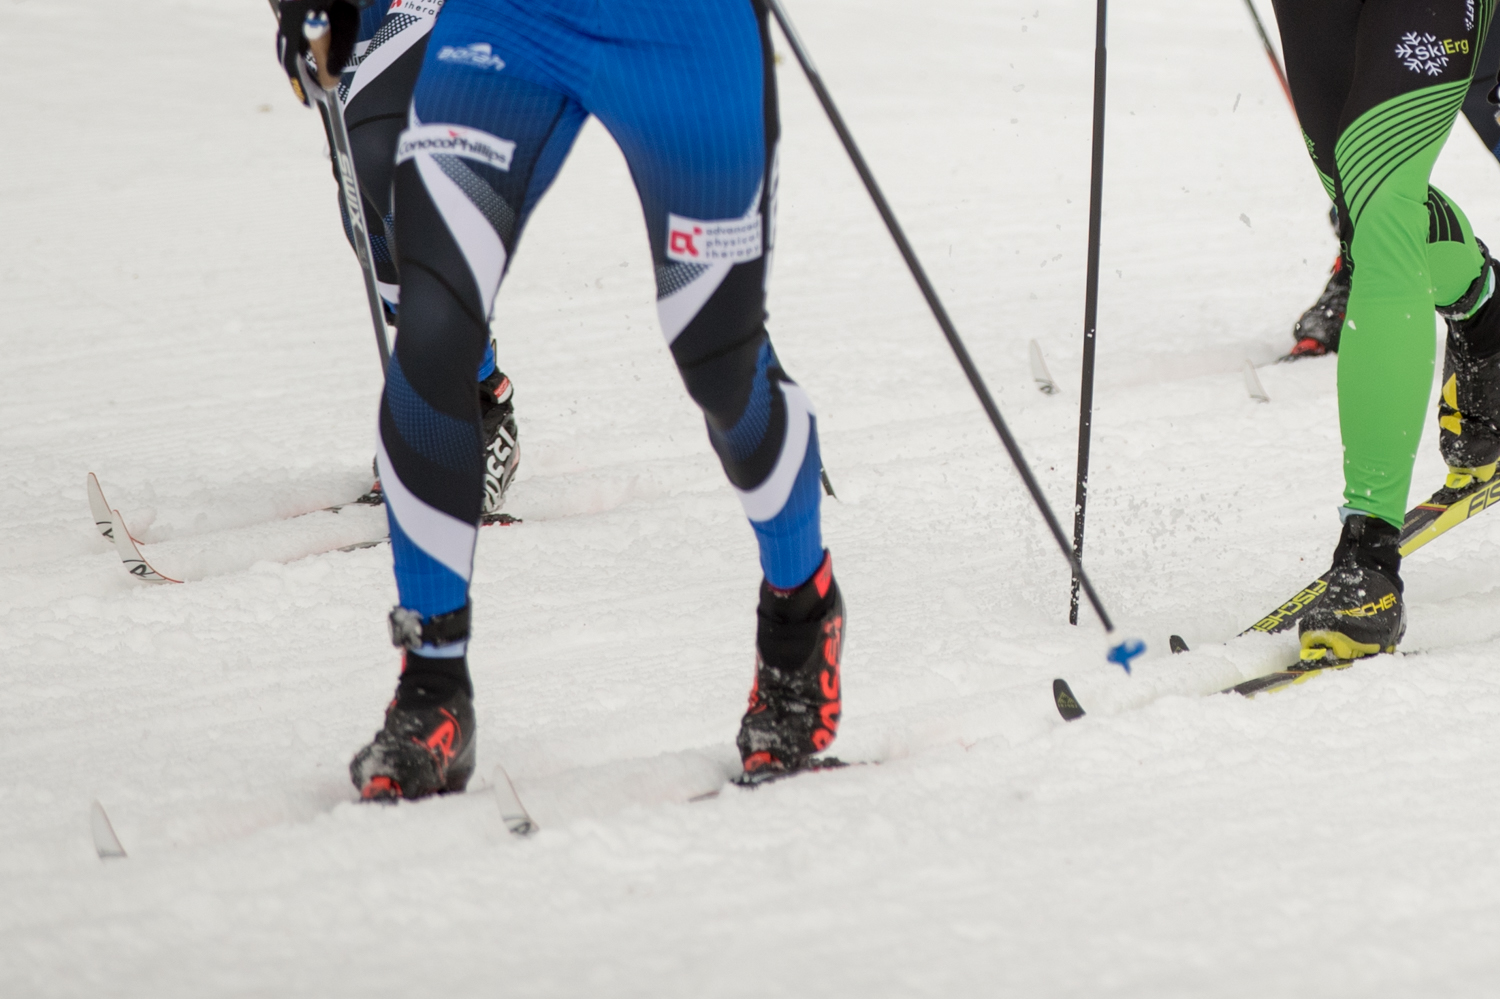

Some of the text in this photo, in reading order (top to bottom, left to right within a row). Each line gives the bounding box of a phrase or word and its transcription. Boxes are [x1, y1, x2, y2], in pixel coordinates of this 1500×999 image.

[1414, 39, 1469, 61] SkiErg
[706, 220, 759, 236] advanced
[706, 231, 759, 247] physical
[706, 245, 759, 259] therapy
